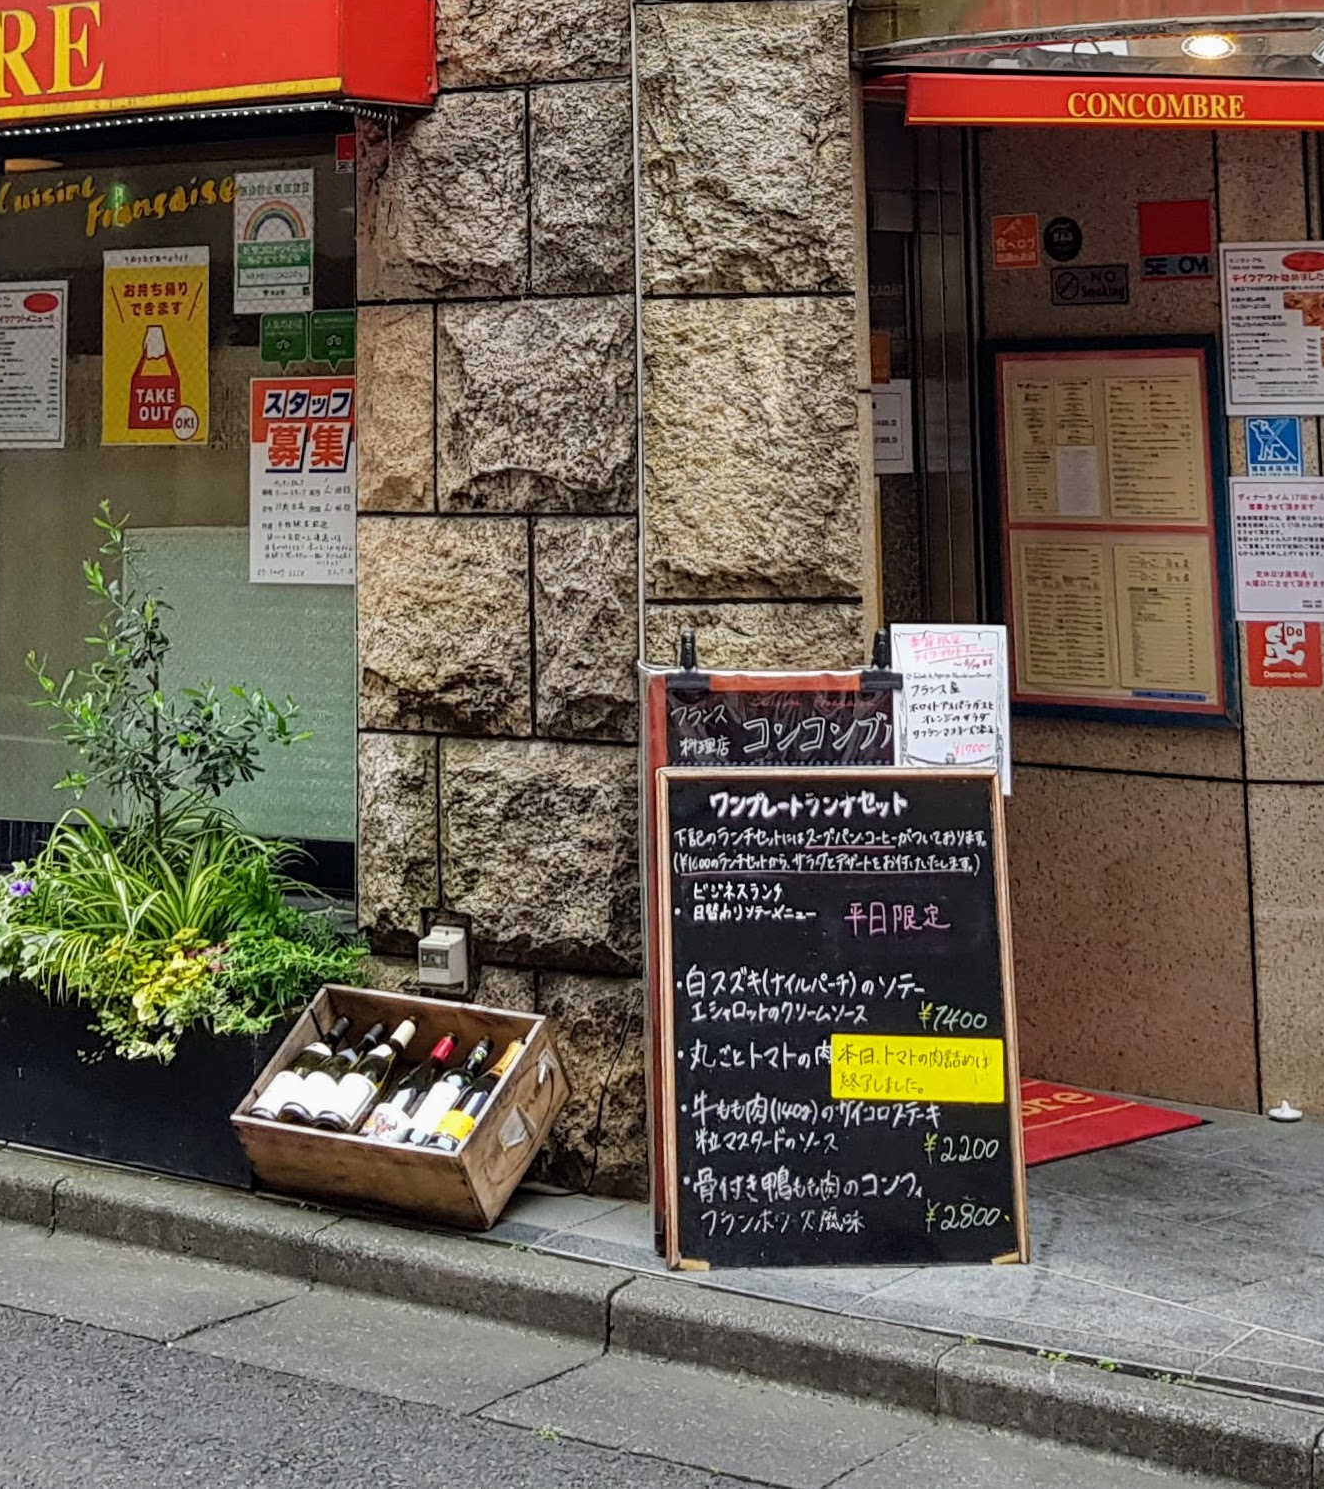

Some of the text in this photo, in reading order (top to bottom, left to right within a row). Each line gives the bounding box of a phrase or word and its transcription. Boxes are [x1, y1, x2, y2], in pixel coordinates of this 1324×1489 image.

[1067, 92, 1246, 119] CONCOMBRE
[1090, 270, 1116, 284] NO
[1144, 256, 1210, 276] SEOM
[123, 281, 189, 298] お持ち帰り
[1080, 284, 1126, 300] Smoking
[130, 301, 184, 316] できます
[135, 388, 176, 404] TAKE
[264, 391, 351, 415] スタッフ
[138, 406, 172, 422] OUT
[175, 416, 195, 430] OK!
[267, 424, 345, 468] 募集
[1285, 625, 1303, 637] Do
[670, 704, 728, 728] フランス
[679, 734, 731, 757] 料理店
[708, 790, 909, 819] ワンプレートランチセット
[692, 880, 784, 901] ビジネスランチ
[843, 901, 952, 937] 平日限定
[691, 1001, 869, 1025] エシャロットのクリームソース
[837, 1043, 991, 1070] 本日、トマトの肉詰めは
[839, 1072, 925, 1094] 終了しました。
[694, 1128, 839, 1157] 粒マスタードのソース
[922, 1132, 1000, 1167] ¥2200
[692, 1168, 923, 1205] 骨付き鴨もも肉のコンフィ
[924, 1197, 1000, 1234] ¥2800
